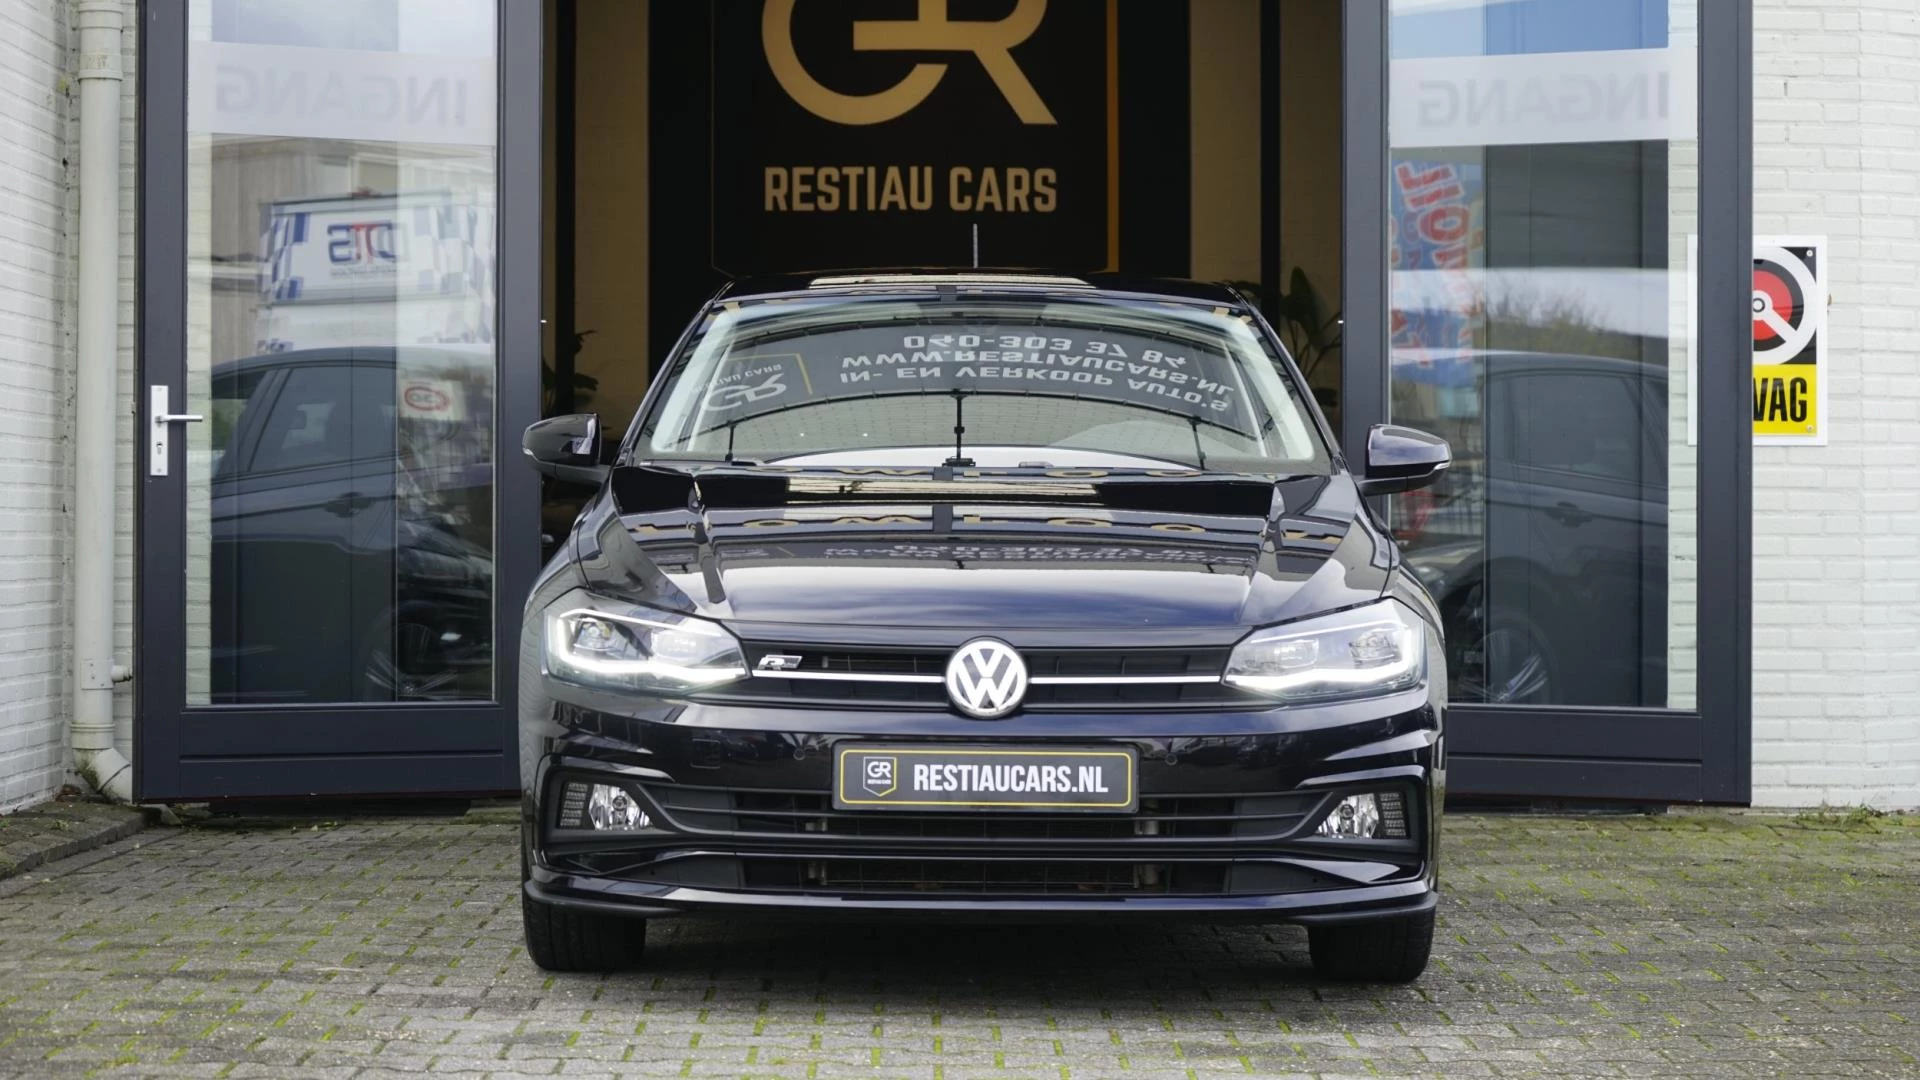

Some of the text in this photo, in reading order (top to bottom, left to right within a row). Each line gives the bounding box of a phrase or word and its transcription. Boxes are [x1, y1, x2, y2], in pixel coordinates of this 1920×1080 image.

[764, 166, 1057, 212] RESTIAU CARS
[1753, 377, 1807, 422] VAG
[867, 761, 892, 778] GR
[913, 764, 1108, 793] RESTIAUCARS.NL
